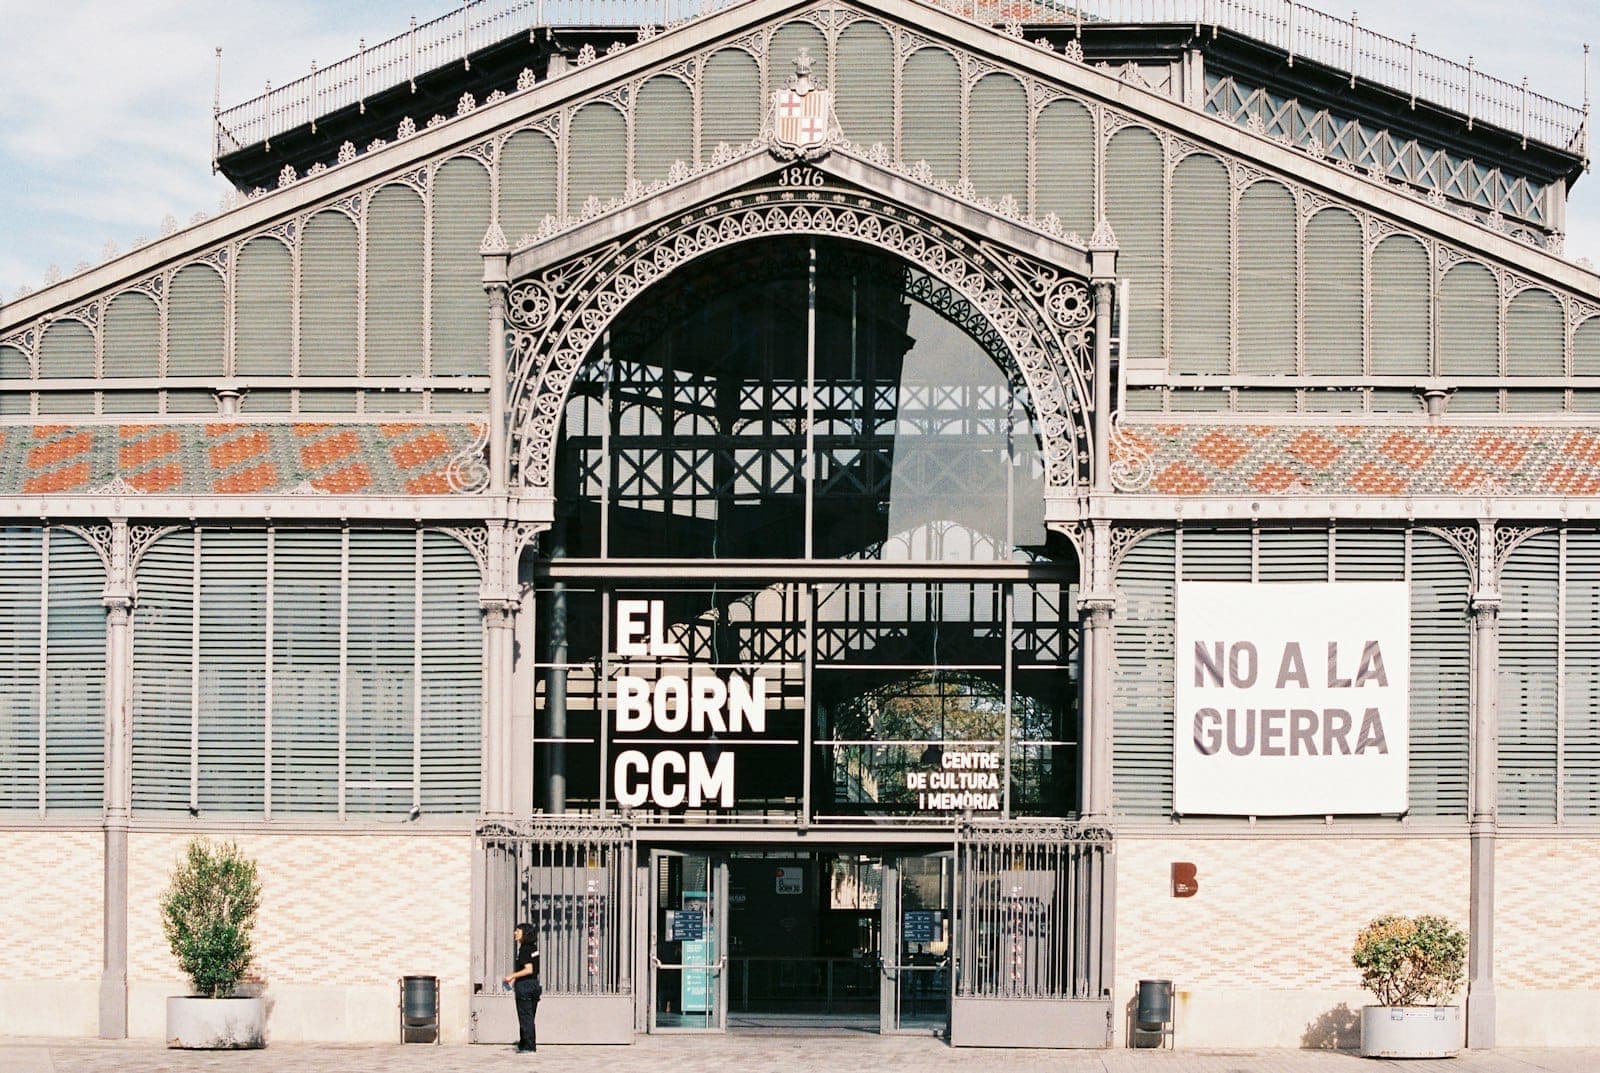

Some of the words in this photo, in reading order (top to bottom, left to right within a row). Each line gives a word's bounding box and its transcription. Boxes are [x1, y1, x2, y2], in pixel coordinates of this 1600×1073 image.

[778, 167, 824, 186] 1876
[616, 599, 680, 656] EL
[1193, 640, 1258, 689] NO
[1275, 641, 1310, 689] A
[1326, 640, 1389, 688] LA
[615, 675, 766, 733] BORN
[1192, 707, 1389, 756] GUERRA
[613, 749, 735, 808] CCM
[906, 772, 927, 789] DE
[930, 772, 999, 789] CULTURA
[942, 752, 999, 769] CENTRE
[919, 793, 925, 809] I
[928, 790, 999, 810] MEMÒRIA
[1171, 862, 1198, 897] B
